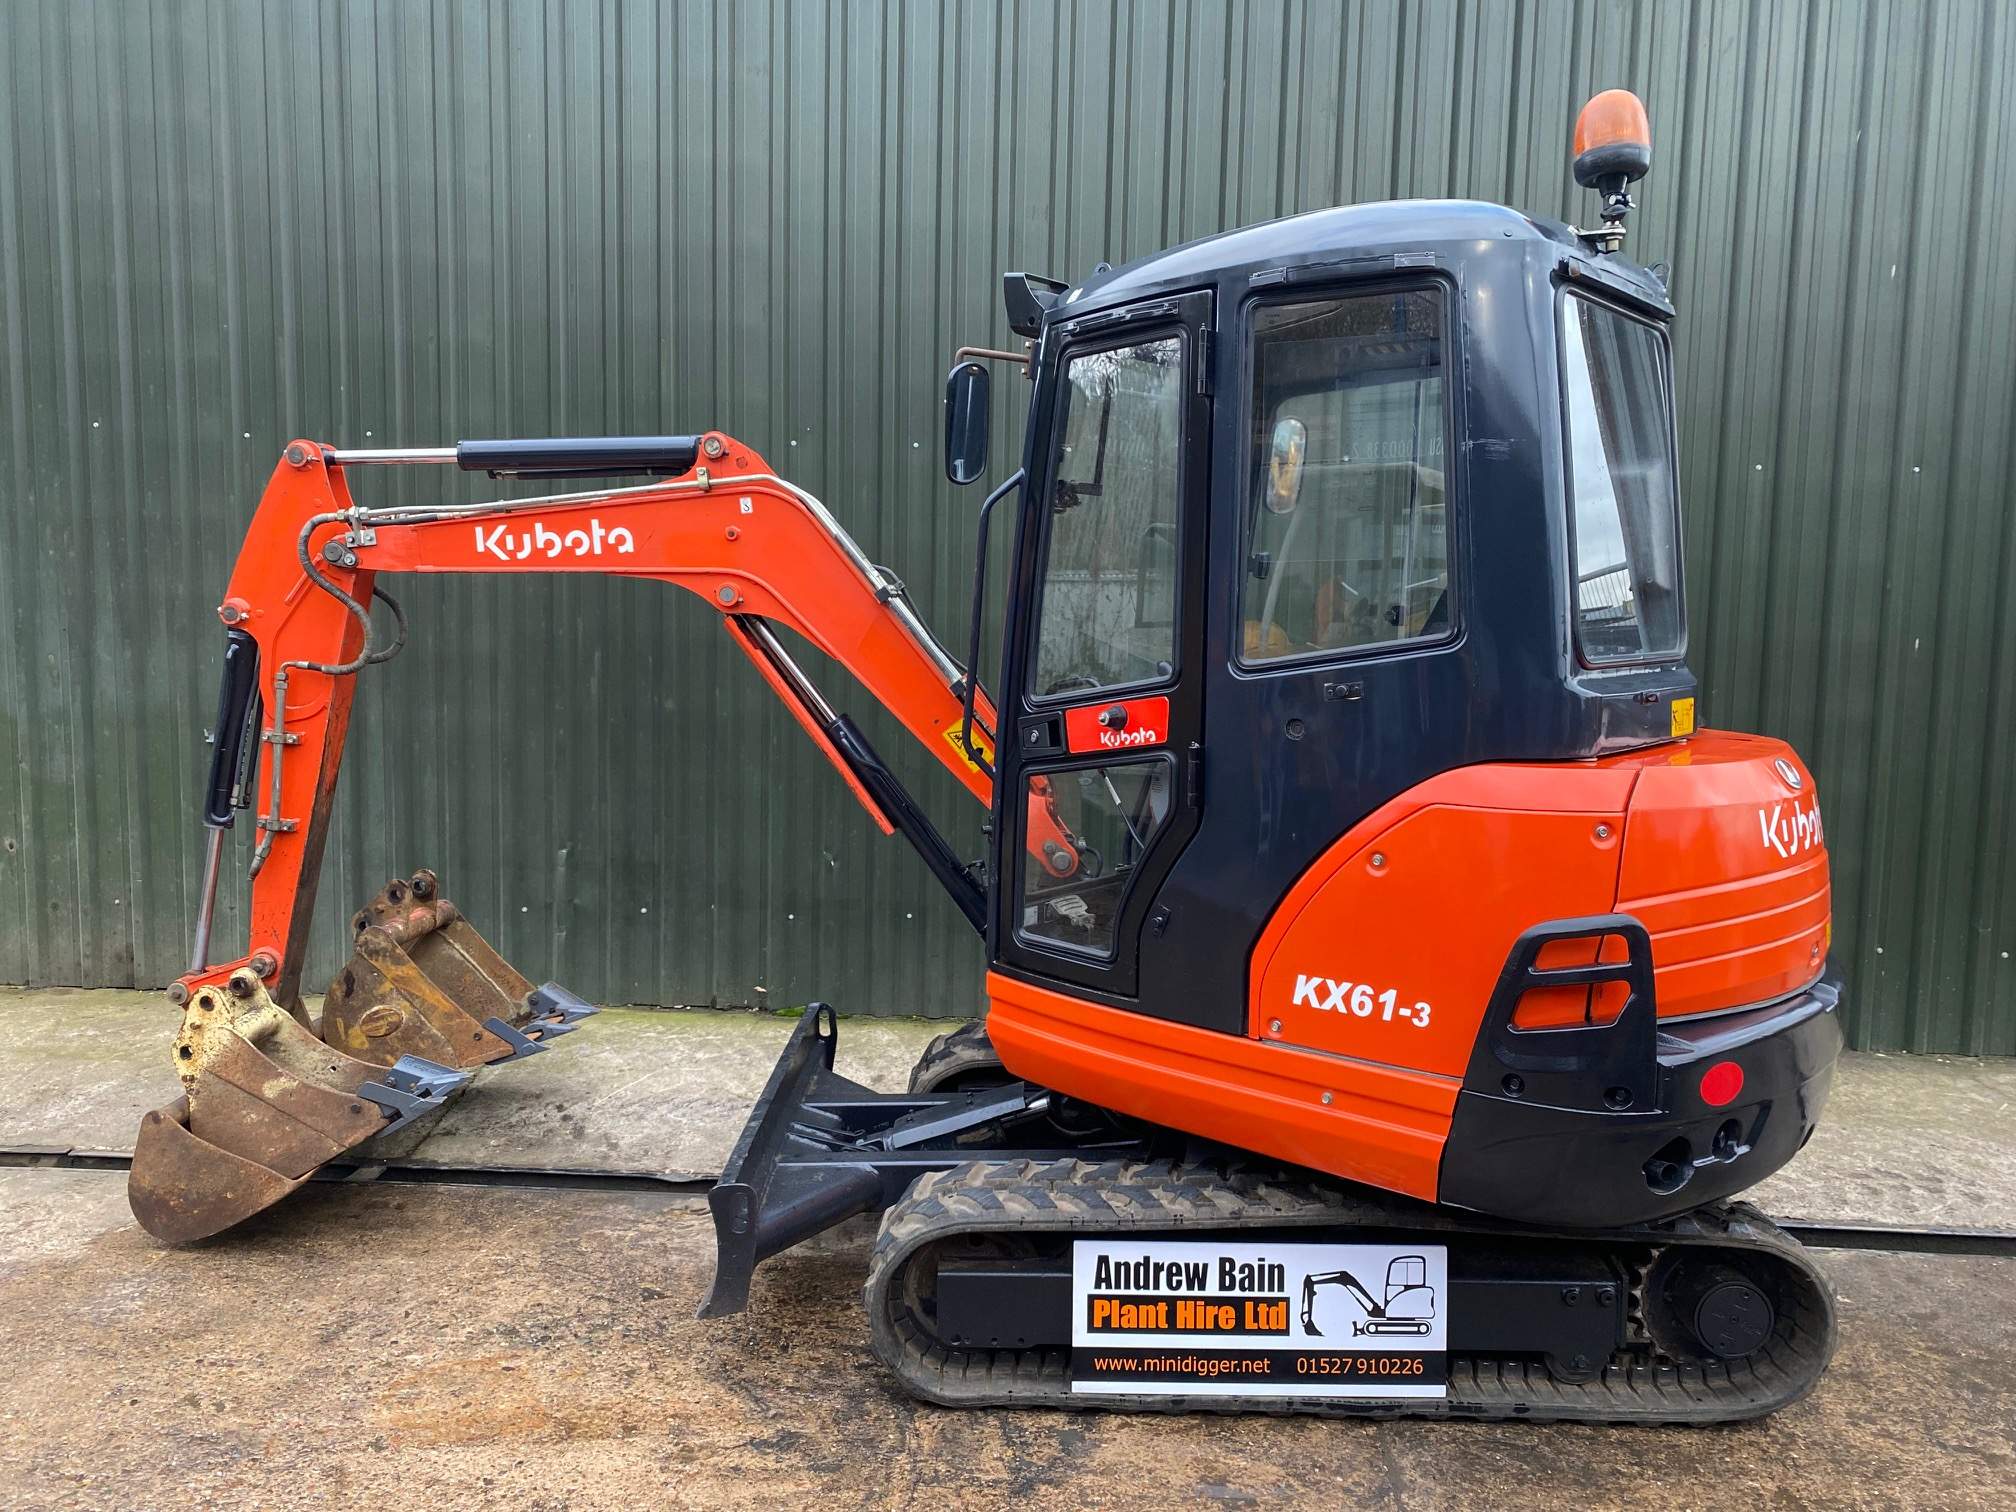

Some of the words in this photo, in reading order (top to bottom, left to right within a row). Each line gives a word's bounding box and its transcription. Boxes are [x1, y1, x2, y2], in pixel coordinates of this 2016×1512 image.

[474, 518, 634, 561] Kubota
[1100, 726, 1156, 747] Kubota
[1759, 793, 1824, 858] Kubot
[1292, 974, 1431, 1028] KX61-3
[1093, 1255, 1209, 1291] Andrew
[1218, 1256, 1285, 1292] Bain
[1093, 1299, 1168, 1329] Plant
[1176, 1300, 1236, 1330] Hire
[1244, 1301, 1287, 1330] Ltd
[1094, 1355, 1271, 1376] www.minidigger.net
[1296, 1357, 1352, 1374] 01527
[1356, 1358, 1424, 1375] 910226
